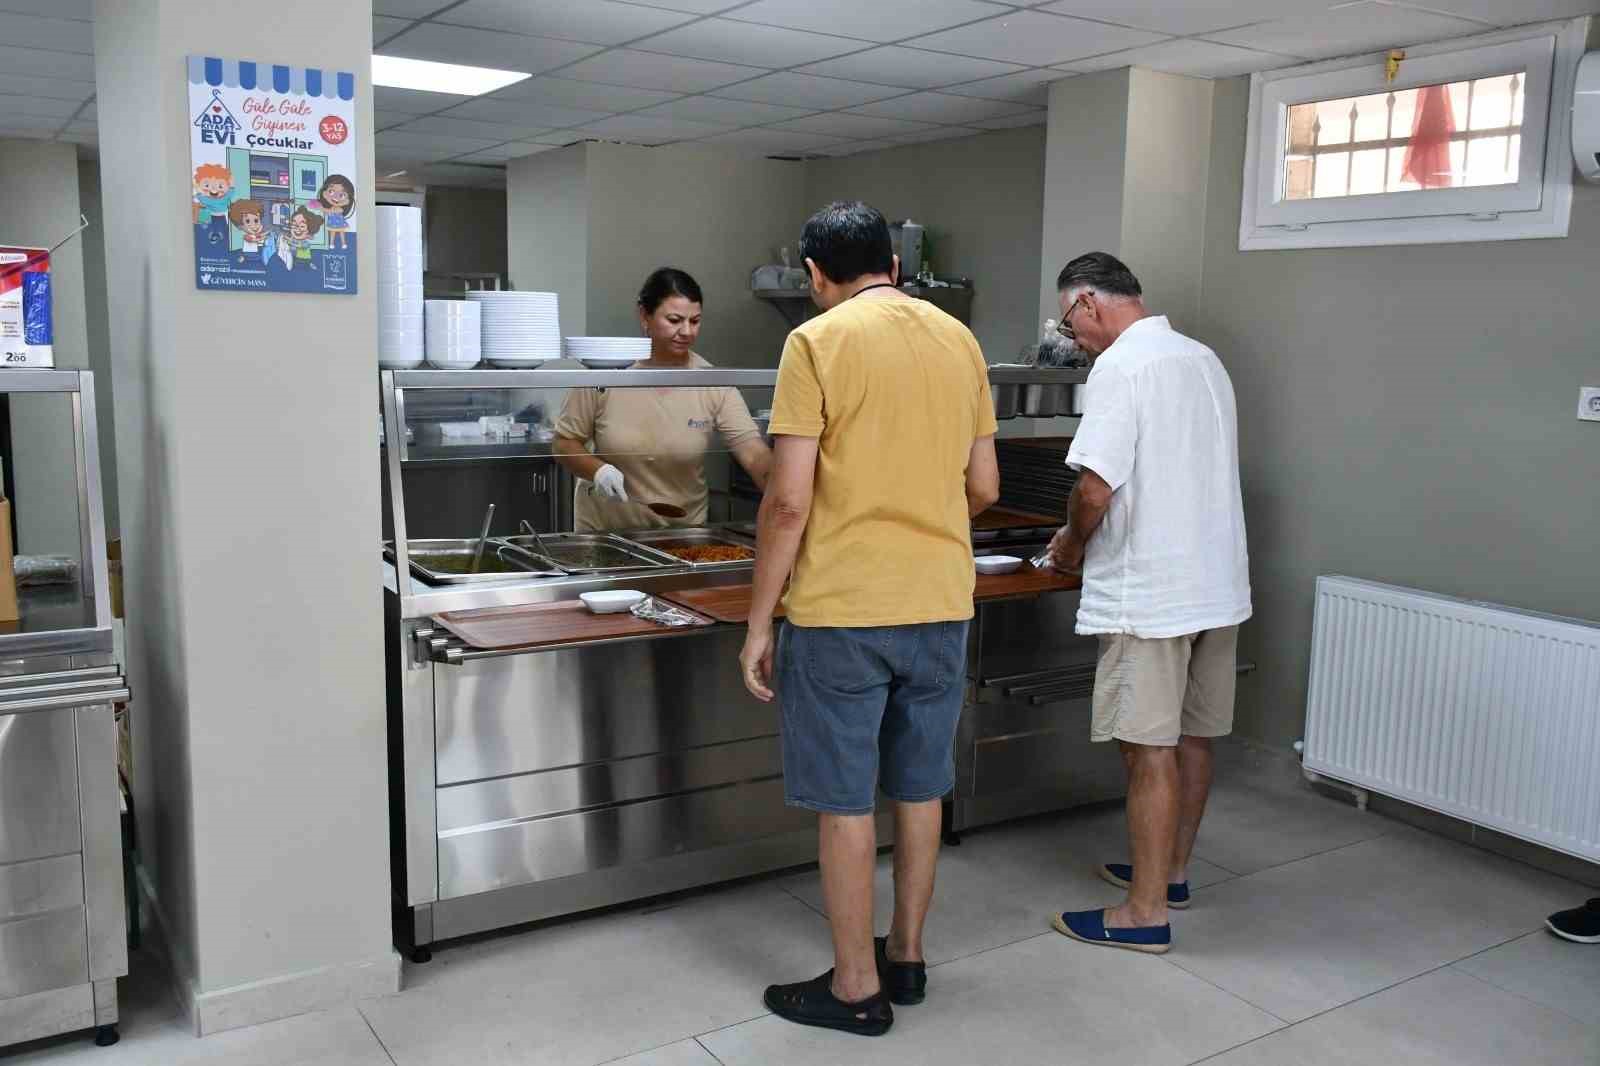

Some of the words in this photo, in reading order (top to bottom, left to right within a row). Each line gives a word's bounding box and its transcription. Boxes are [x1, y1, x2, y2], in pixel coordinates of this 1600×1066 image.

[201, 114, 234, 127] ADA
[321, 122, 345, 133] 3-12
[201, 129, 236, 145] EVİ
[246, 134, 314, 150] Çocuklar
